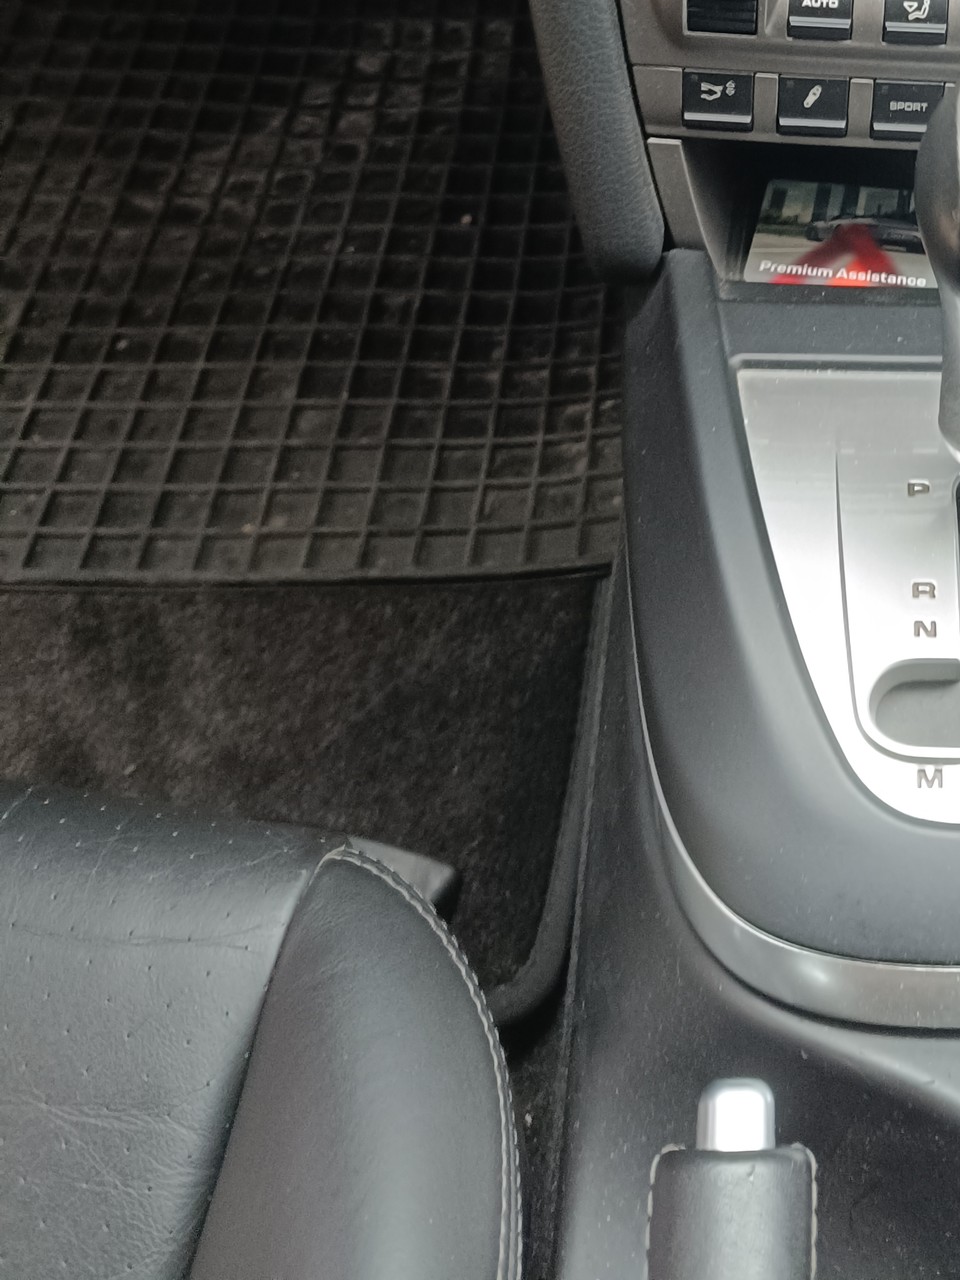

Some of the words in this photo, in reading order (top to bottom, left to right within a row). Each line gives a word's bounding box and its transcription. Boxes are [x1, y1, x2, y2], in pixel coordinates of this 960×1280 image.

[889, 100, 928, 112] SPORT
[759, 259, 833, 279] Premium
[835, 268, 927, 288] Assistance
[907, 481, 930, 497] P
[911, 581, 936, 598] R
[913, 620, 937, 638] N
[916, 767, 943, 789] M
